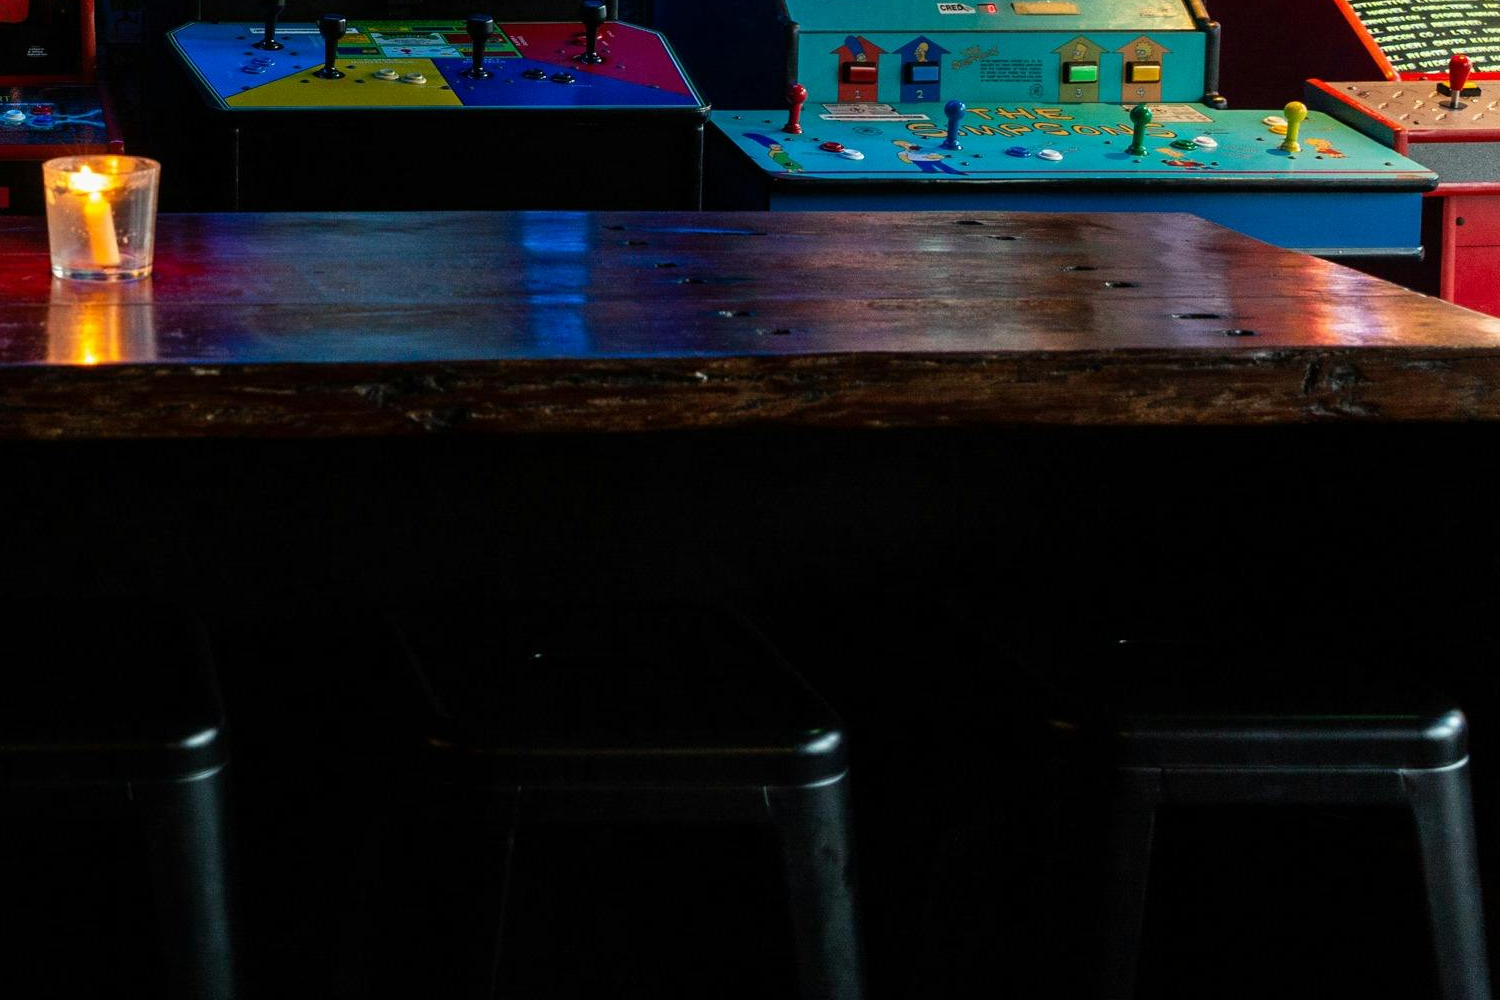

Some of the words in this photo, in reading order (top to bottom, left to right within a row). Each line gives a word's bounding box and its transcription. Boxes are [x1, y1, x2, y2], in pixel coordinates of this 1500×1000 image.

[1386, 23, 1427, 32] RIGHTS
[1406, 49, 1448, 59] RIGHTS
[855, 90, 860, 98] 1
[916, 90, 924, 98] 2
[1074, 88, 1083, 97] 3
[1136, 86, 1146, 96] 4
[965, 107, 1074, 121] THE
[905, 121, 1180, 139] SMPSONS
